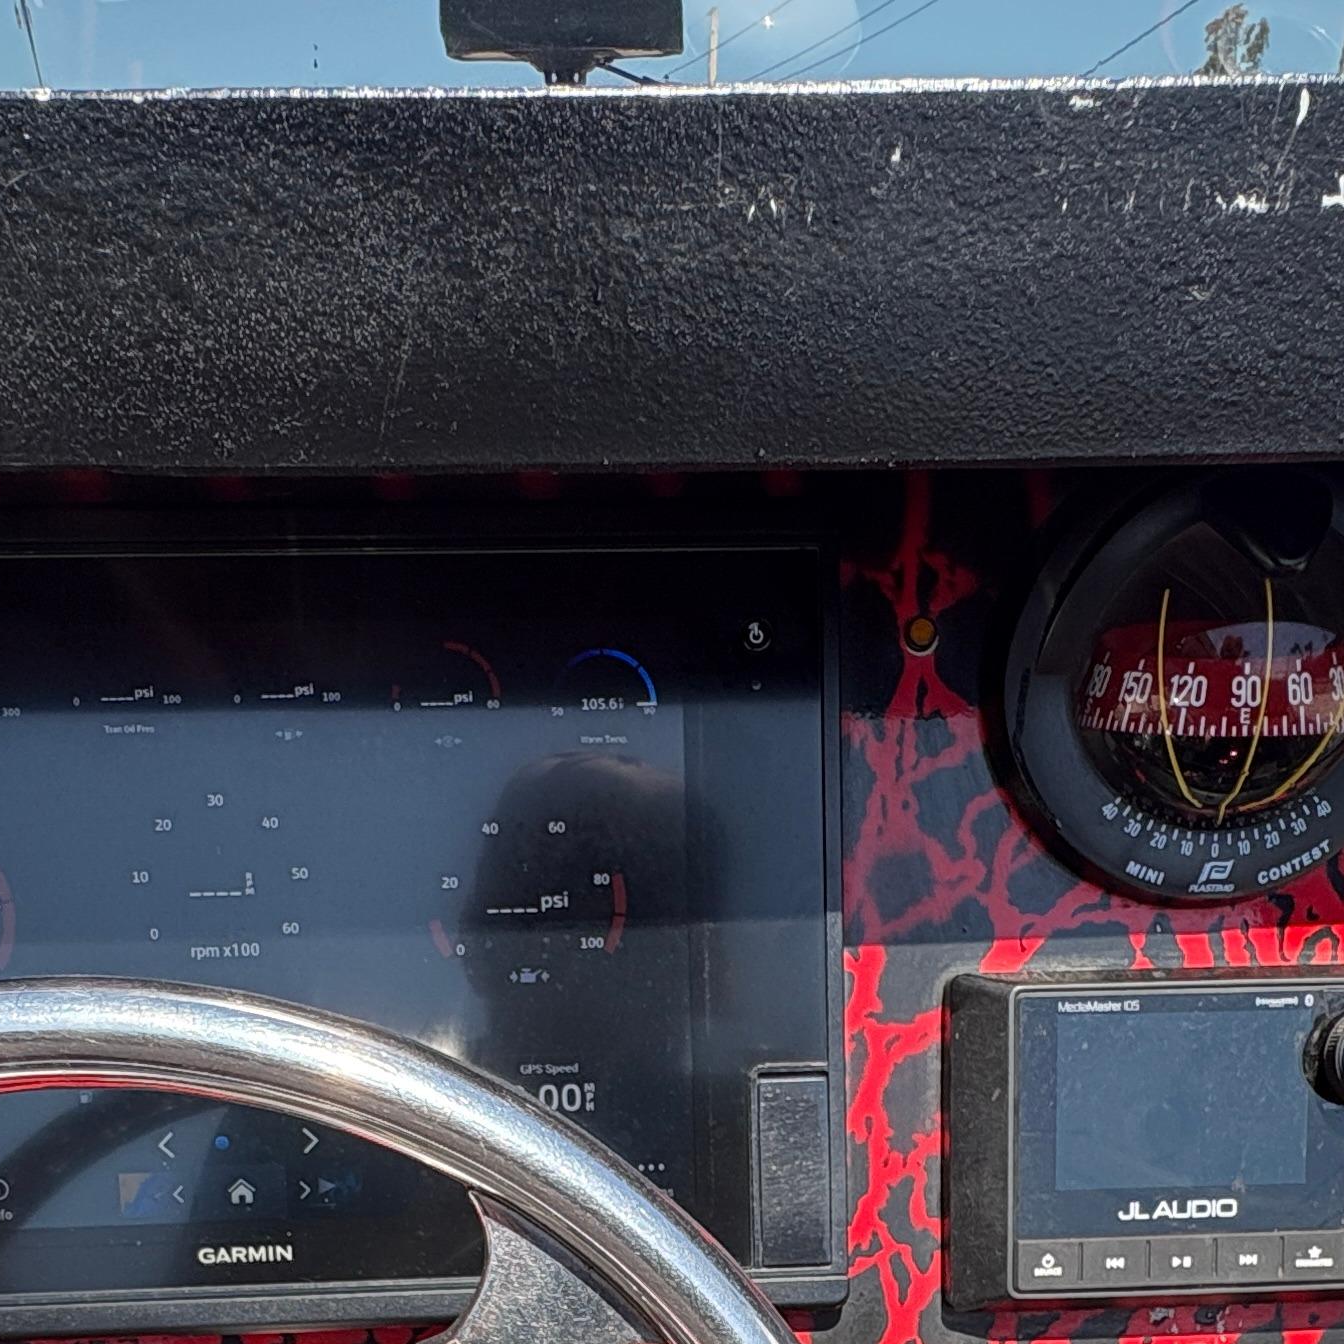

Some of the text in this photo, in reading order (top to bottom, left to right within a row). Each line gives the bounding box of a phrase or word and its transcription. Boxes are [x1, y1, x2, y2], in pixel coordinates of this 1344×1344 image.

[134, 686, 154, 700] psi
[162, 694, 182, 705] 100
[294, 683, 315, 698] psi
[321, 691, 342, 702] 100
[1119, 671, 1154, 704] 150
[1169, 673, 1209, 708] 120
[1230, 673, 1262, 707] 90
[1287, 671, 1313, 705] 60
[454, 690, 474, 705] psi
[1239, 708, 1251, 725] E
[207, 794, 224, 807] 30
[1315, 799, 1333, 818] 40
[1101, 802, 1119, 822] 40
[155, 819, 172, 831] 20
[261, 816, 279, 829] 40
[481, 822, 499, 835] 40
[548, 821, 566, 834] 60
[1123, 818, 1142, 838] 30
[1289, 817, 1308, 836] 30
[1149, 831, 1168, 850] 20
[1179, 840, 1194, 857] 10
[1237, 839, 1251, 856] 10
[1264, 830, 1281, 850] 20
[1210, 842, 1220, 858] 0
[1257, 838, 1332, 886] CONTEST
[132, 871, 149, 883] 10
[291, 867, 308, 880] 50
[593, 873, 610, 886] 80
[1125, 860, 1166, 886] MINI
[441, 877, 459, 889] 20
[540, 891, 569, 913] psi
[150, 928, 159, 940] 0
[282, 922, 299, 935] 60
[190, 942, 260, 961] rpm x100
[456, 943, 466, 956] 0
[579, 937, 605, 949] 100
[519, 1063, 579, 1076] GPS Speed
[1117, 1198, 1238, 1221] JL AUDIO
[197, 1244, 294, 1266] GARMIN
